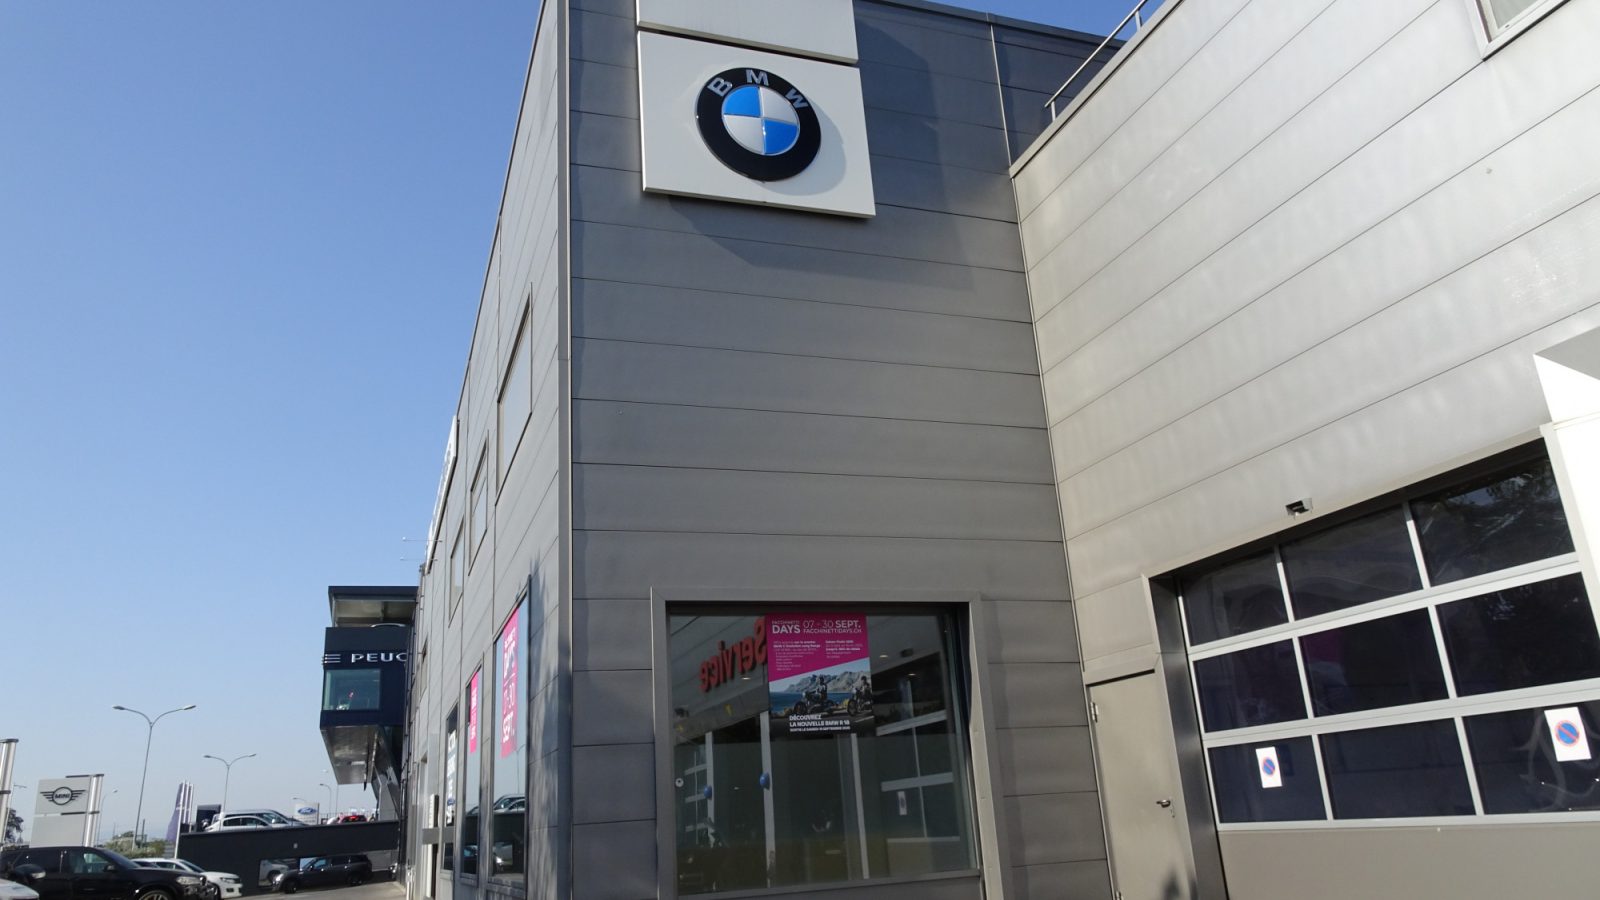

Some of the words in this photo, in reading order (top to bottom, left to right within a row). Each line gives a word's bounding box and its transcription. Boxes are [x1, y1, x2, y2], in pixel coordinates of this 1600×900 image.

[707, 69, 809, 109] BMW
[772, 624, 801, 634] DAYS
[803, 620, 814, 629] 07
[823, 620, 834, 629] 30
[835, 620, 861, 629] SEPT.
